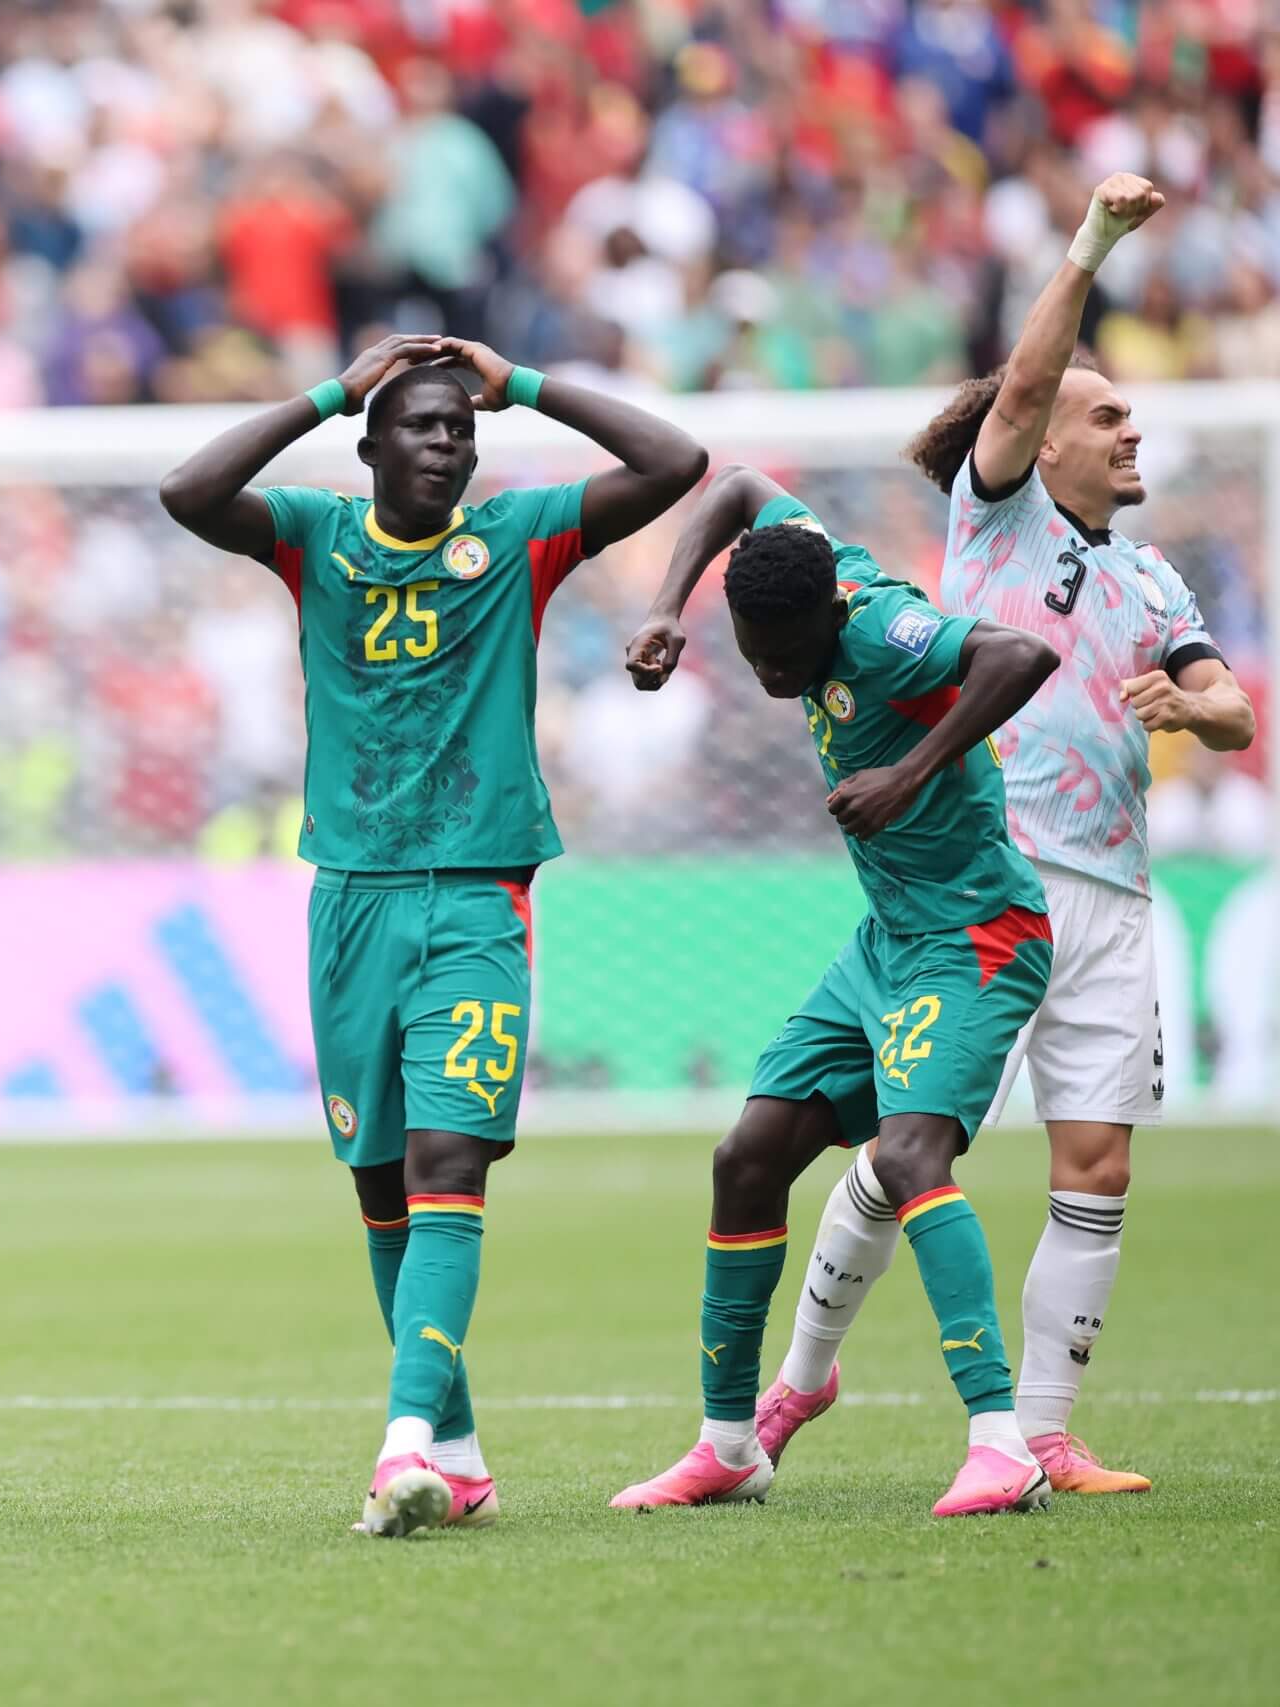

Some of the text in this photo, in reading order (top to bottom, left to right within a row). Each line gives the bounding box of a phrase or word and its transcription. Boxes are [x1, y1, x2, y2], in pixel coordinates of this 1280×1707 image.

[1044, 550, 1087, 616] 3
[364, 580, 441, 662] 25
[443, 1000, 521, 1082] 25
[879, 994, 942, 1069] 22
[1073, 1314, 1104, 1331] RB
